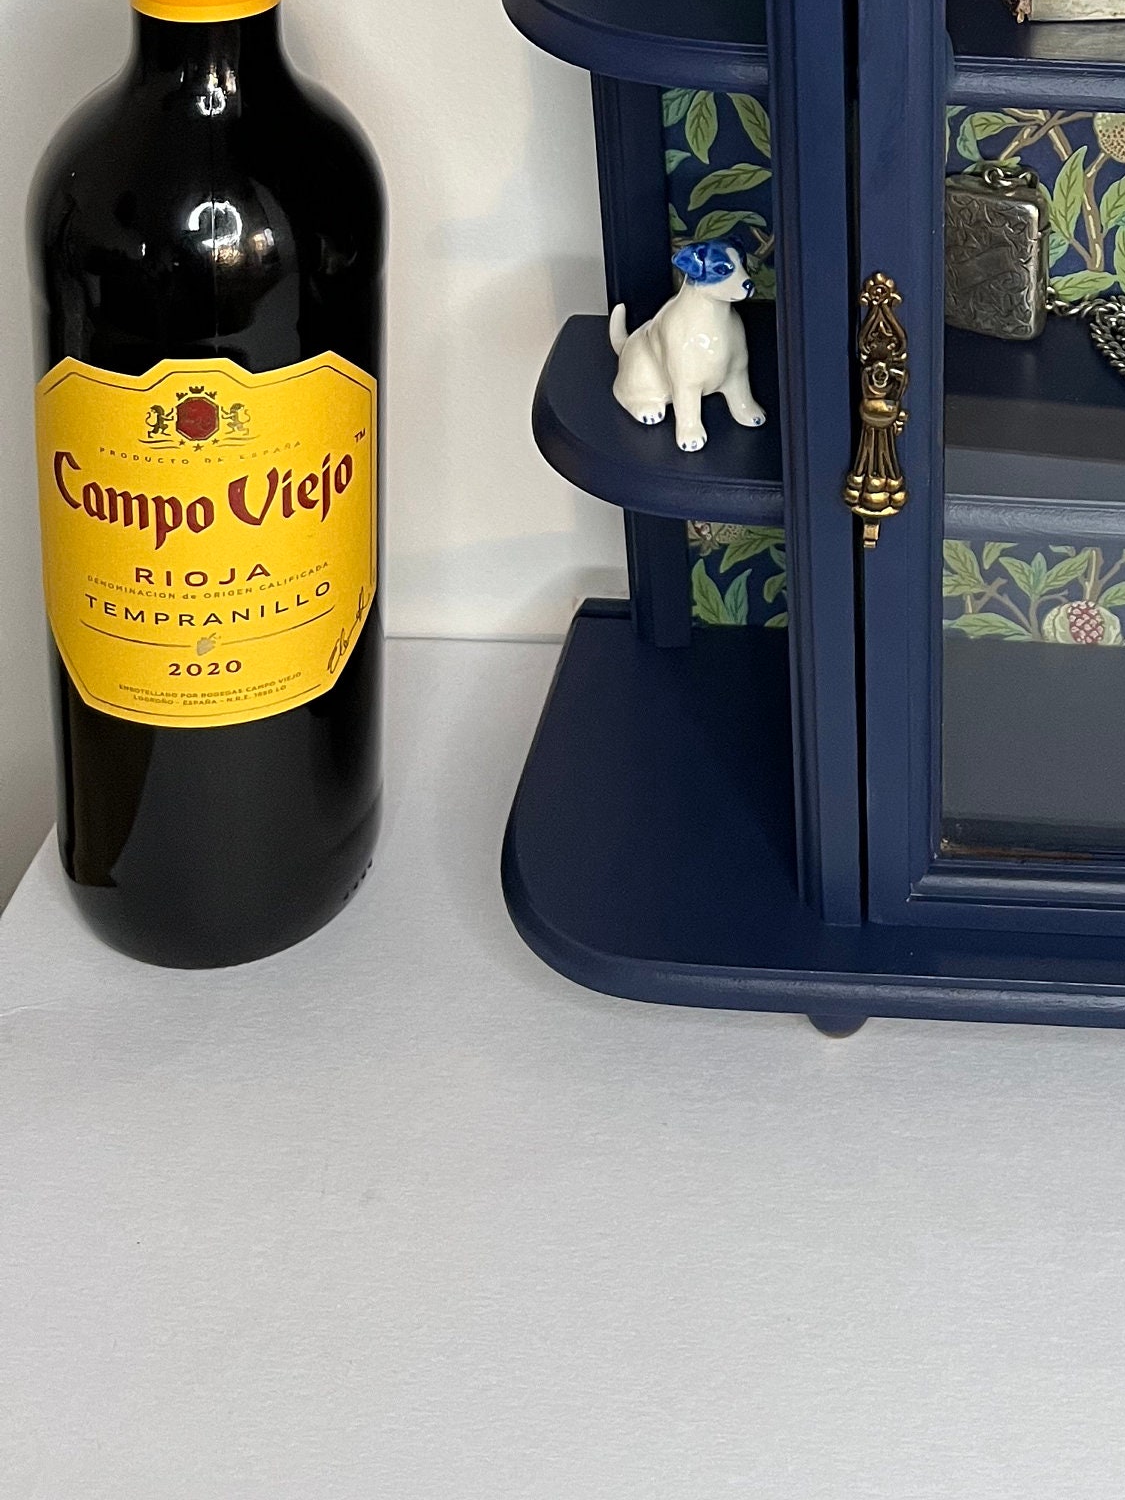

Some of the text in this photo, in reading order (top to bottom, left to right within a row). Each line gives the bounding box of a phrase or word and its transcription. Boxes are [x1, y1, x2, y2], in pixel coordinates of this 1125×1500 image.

[99, 446, 190, 465] PRODUCTO
[53, 451, 215, 551] Campo
[228, 452, 353, 526] Viejo
[134, 562, 272, 588] RIOJA
[203, 586, 253, 599] ORIGEN
[258, 561, 330, 592] CALIFICADA
[84, 579, 331, 627] TEMPRANILLO
[168, 659, 244, 677] 2020
[200, 688, 243, 699] BODEGAS
[245, 681, 276, 693] CAMPO
[278, 671, 302, 684] VIEJO
